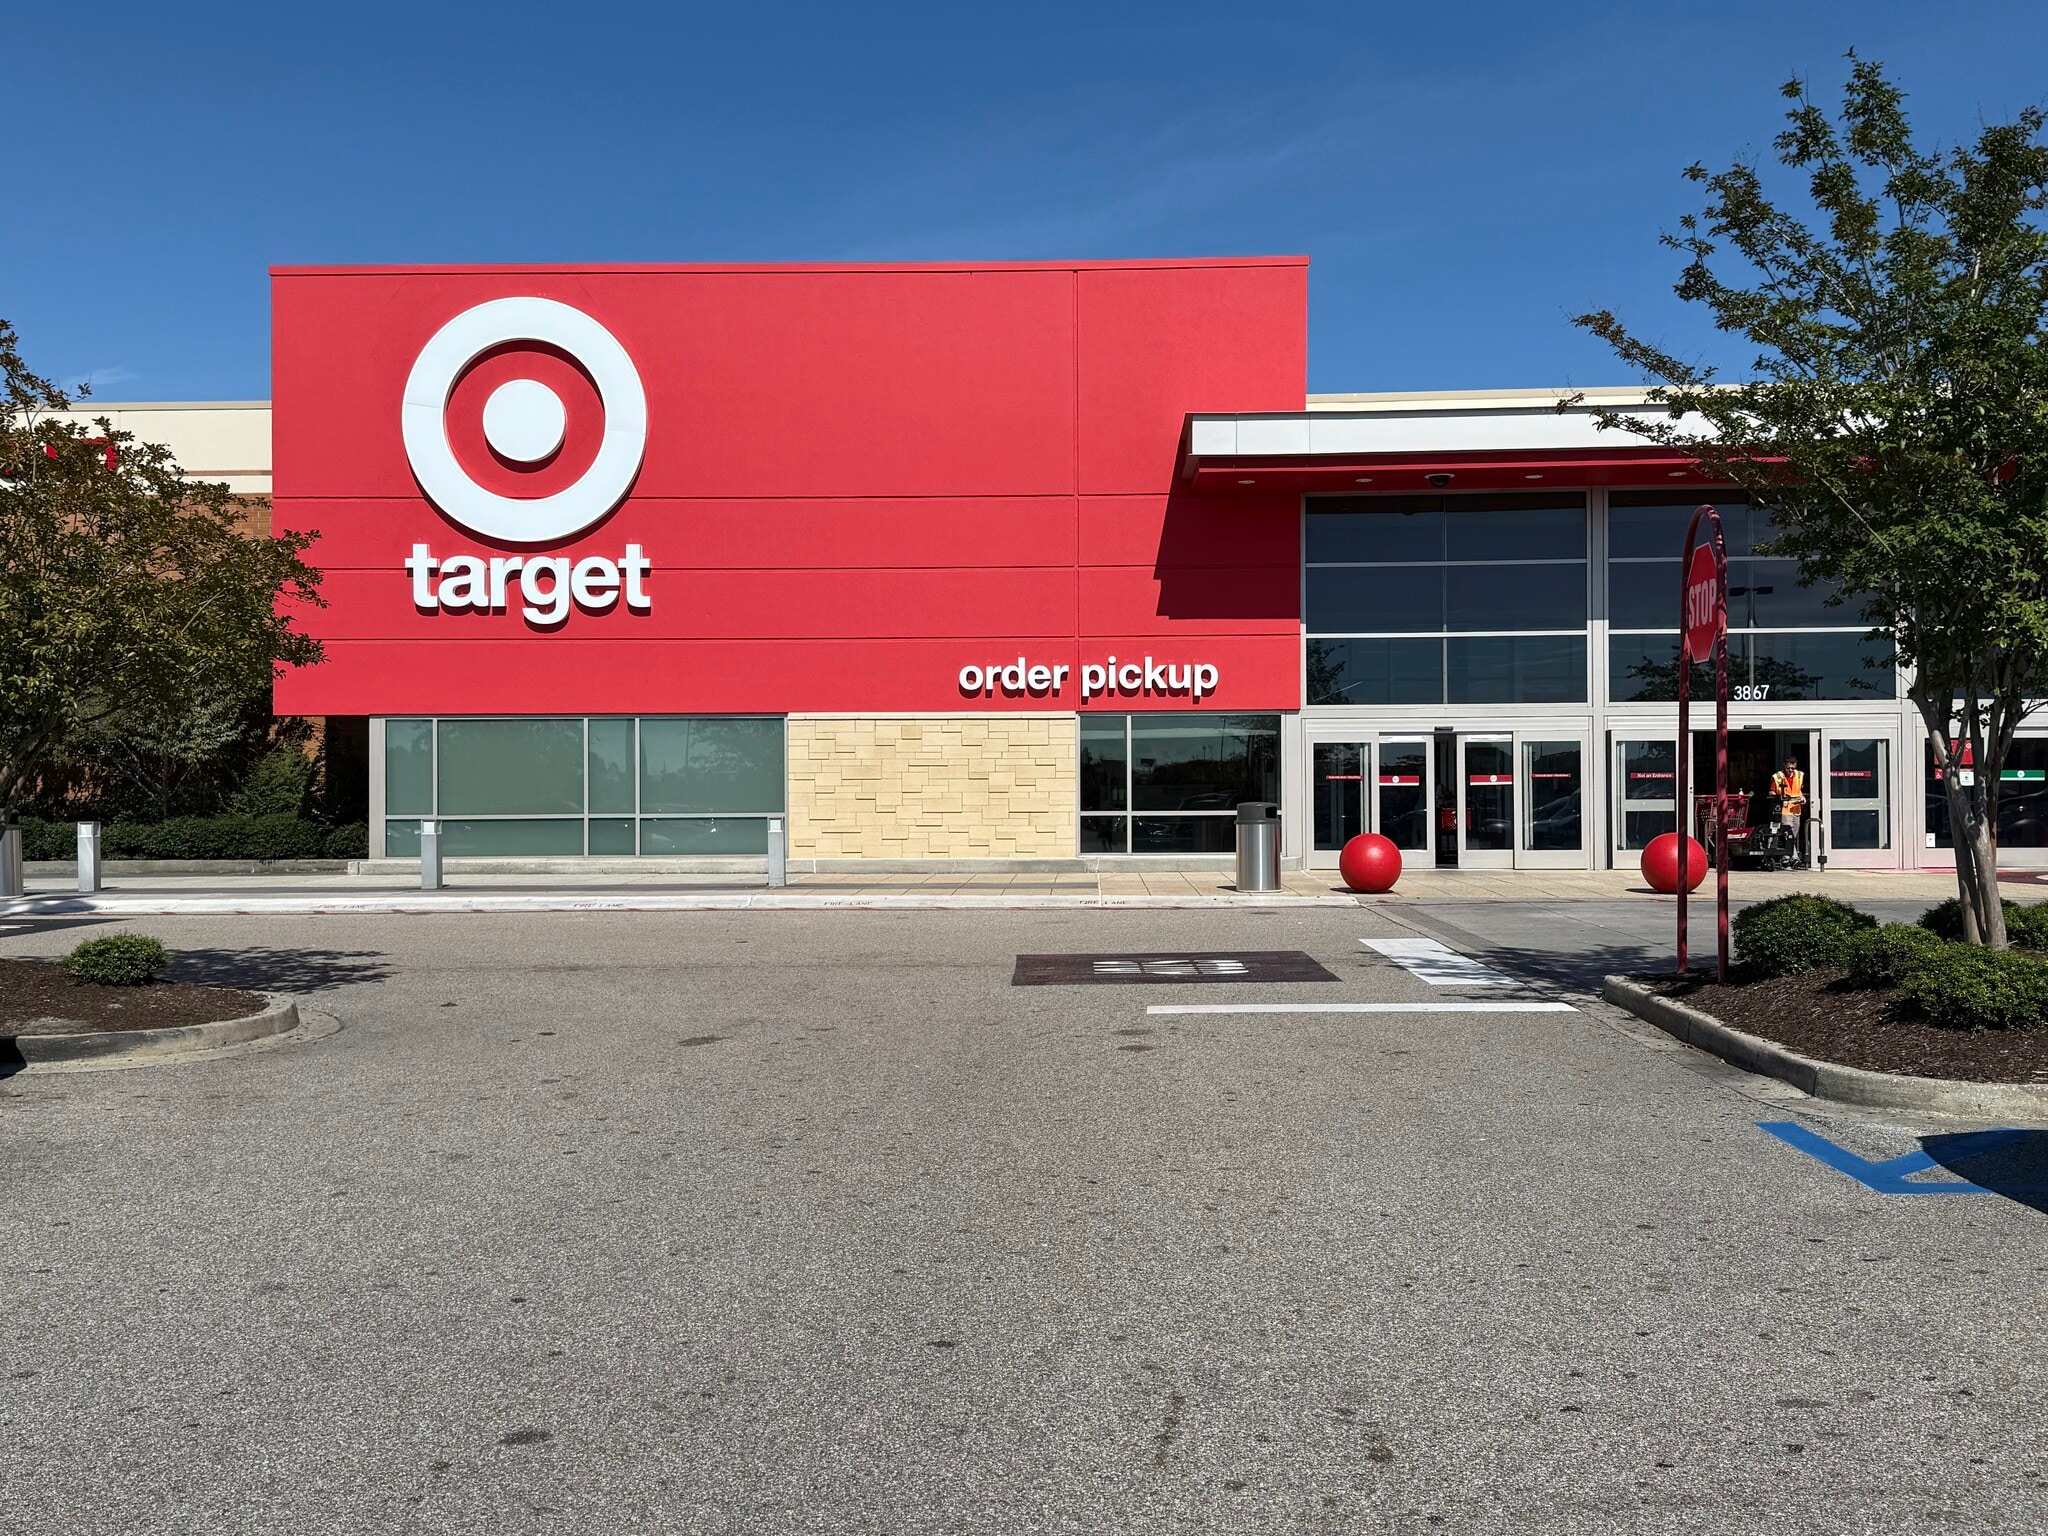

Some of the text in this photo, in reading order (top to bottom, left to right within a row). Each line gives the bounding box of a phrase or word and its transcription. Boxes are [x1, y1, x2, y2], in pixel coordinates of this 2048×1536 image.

[404, 543, 651, 625] target
[1688, 578, 1717, 630] STOP
[958, 655, 1219, 697] order pickup
[1733, 684, 1770, 701] 3867
